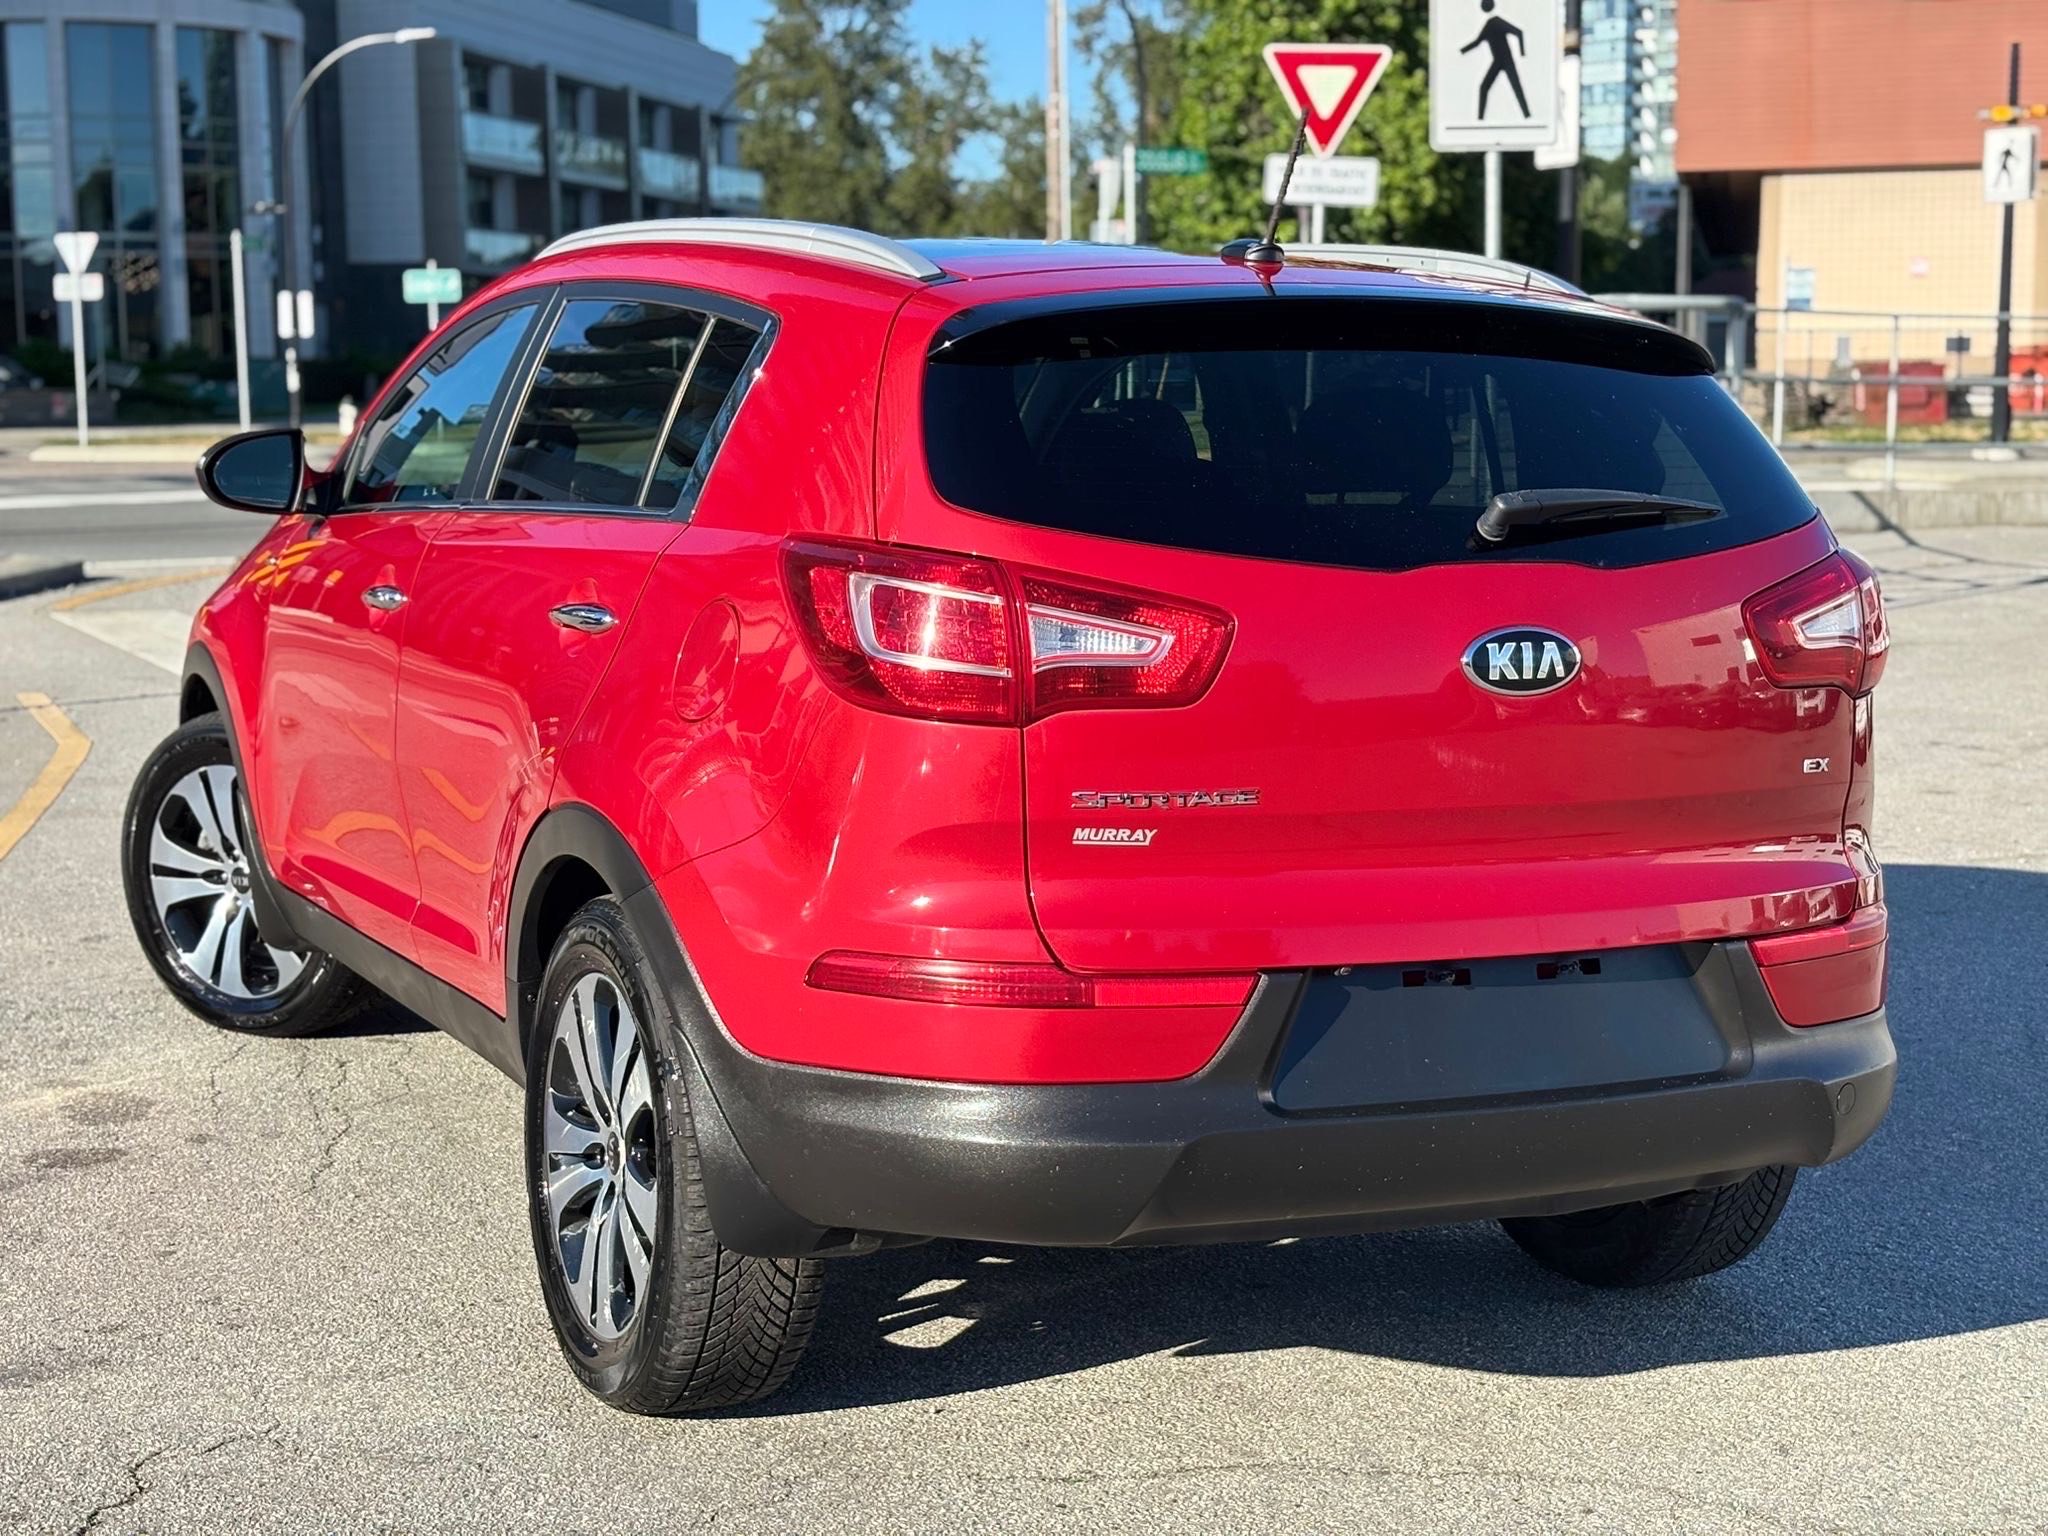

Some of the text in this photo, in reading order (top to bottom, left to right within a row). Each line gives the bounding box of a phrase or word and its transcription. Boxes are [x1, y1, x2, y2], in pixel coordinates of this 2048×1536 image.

[1486, 641, 1565, 680] KIA
[1803, 757, 1830, 773] EX
[1071, 787, 1260, 809] SPORTAGE
[1072, 828, 1158, 846] MURRAY
